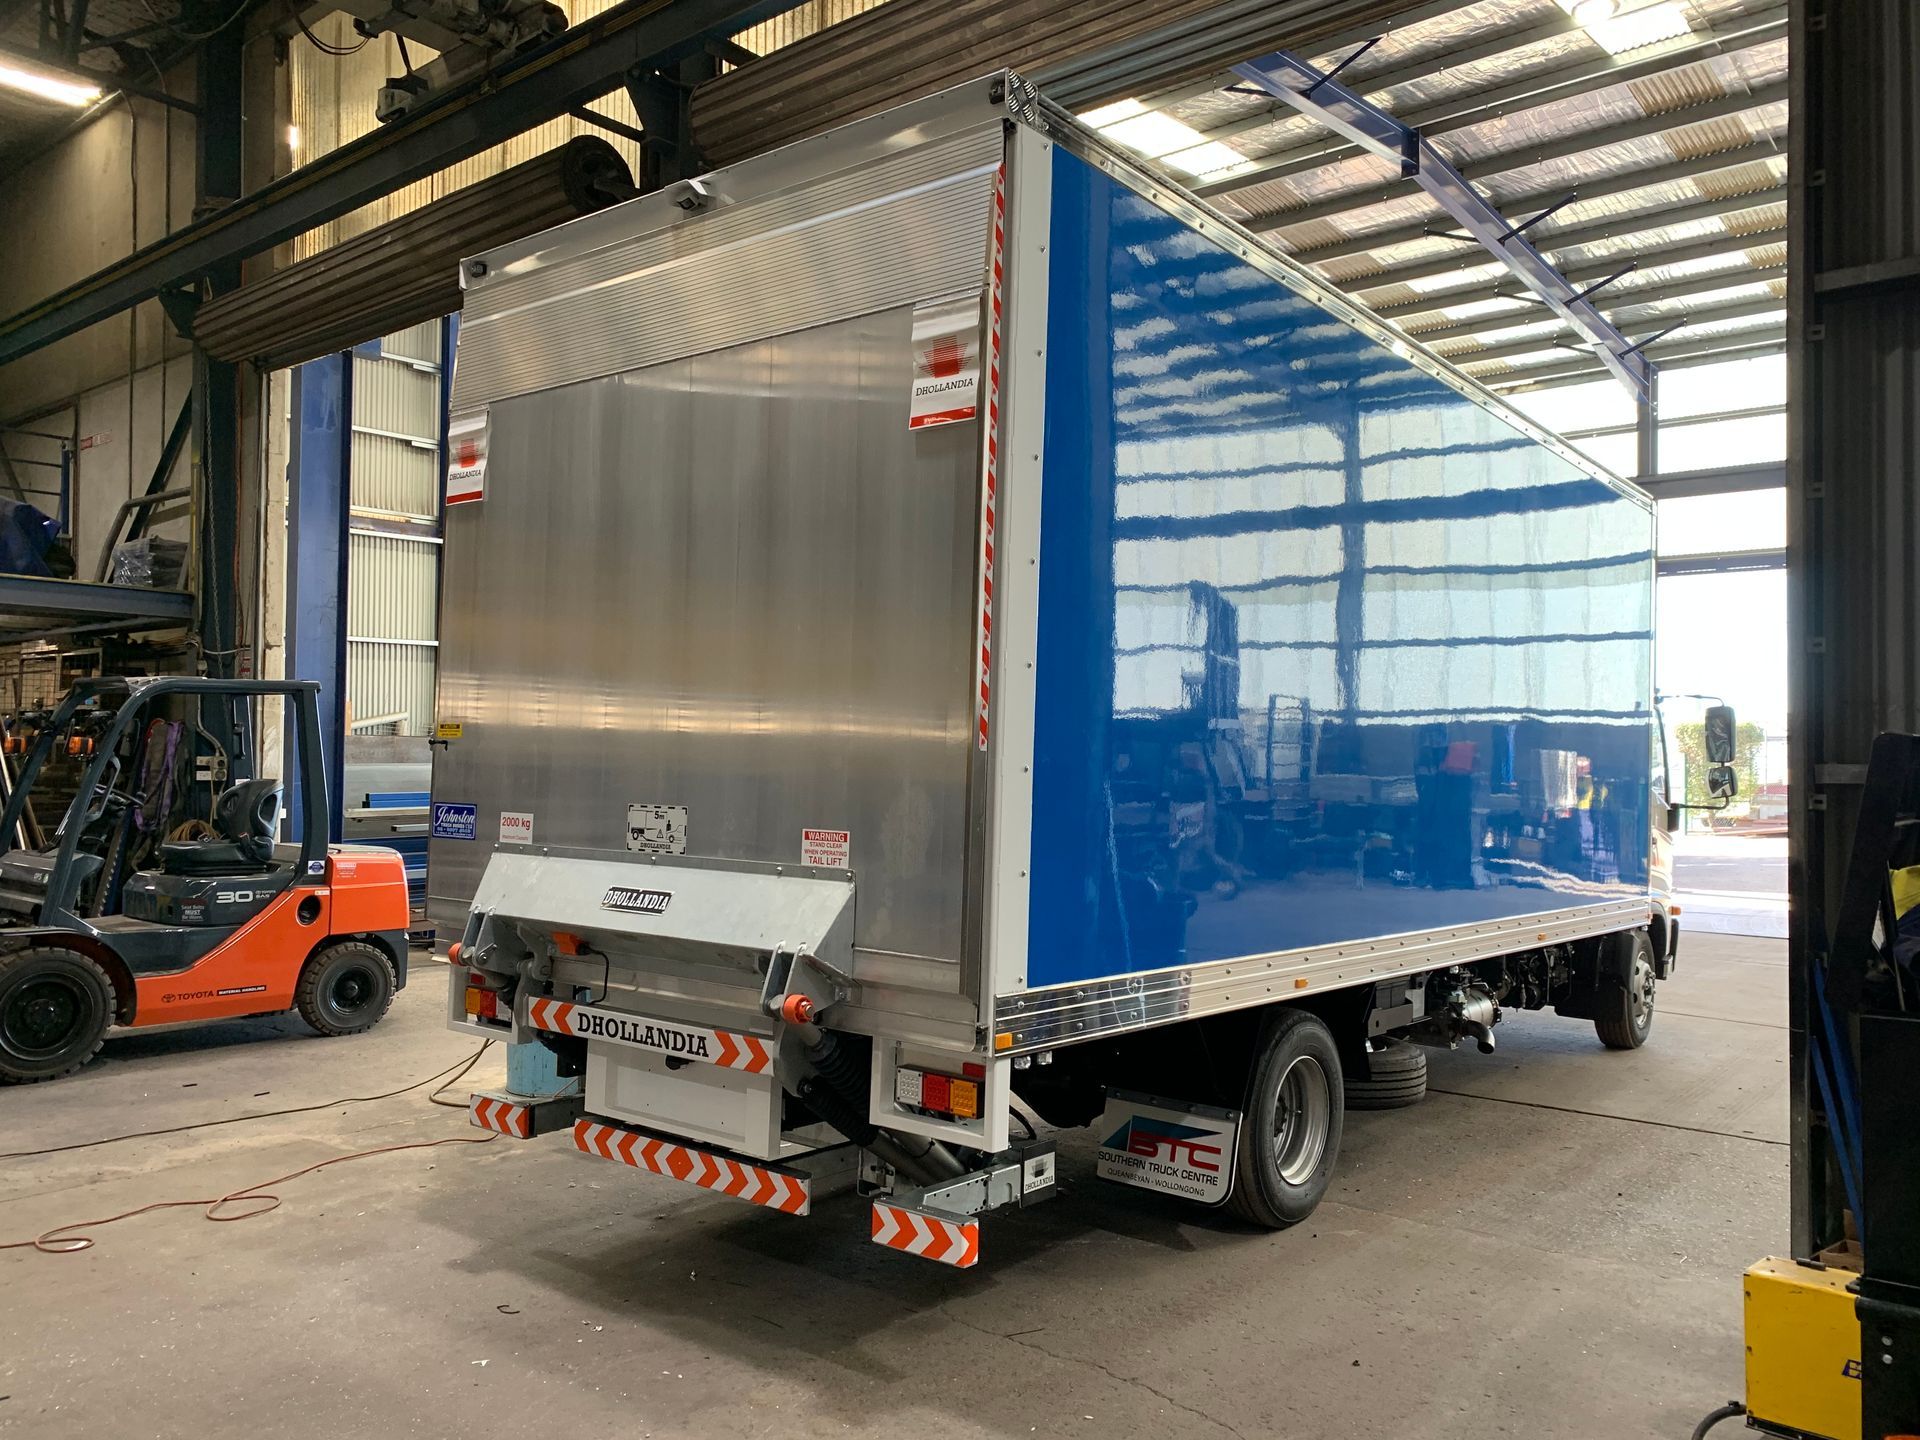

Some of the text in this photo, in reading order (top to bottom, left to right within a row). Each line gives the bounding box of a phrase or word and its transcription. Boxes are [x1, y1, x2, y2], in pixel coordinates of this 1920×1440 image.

[916, 378, 974, 397] DHOLLANDIA
[434, 806, 475, 826] Johnston
[502, 816, 530, 830] 2000 kg
[808, 831, 845, 842] WARNING
[640, 842, 672, 850] DHOLLANDIA
[804, 848, 847, 857] WHEN OPERATING
[809, 855, 842, 866] TAIL LIFT
[216, 891, 254, 903] 30
[602, 890, 669, 910] DHOLLANDIA
[177, 990, 214, 1000] TOYOTA
[577, 1012, 709, 1058] DHOLLANDIA
[1098, 1150, 1219, 1186] SOUTHERN TRUCK CENTRE
[1107, 1167, 1151, 1184] QUEANBEYAN
[1155, 1179, 1205, 1197] WOLLONGONG
